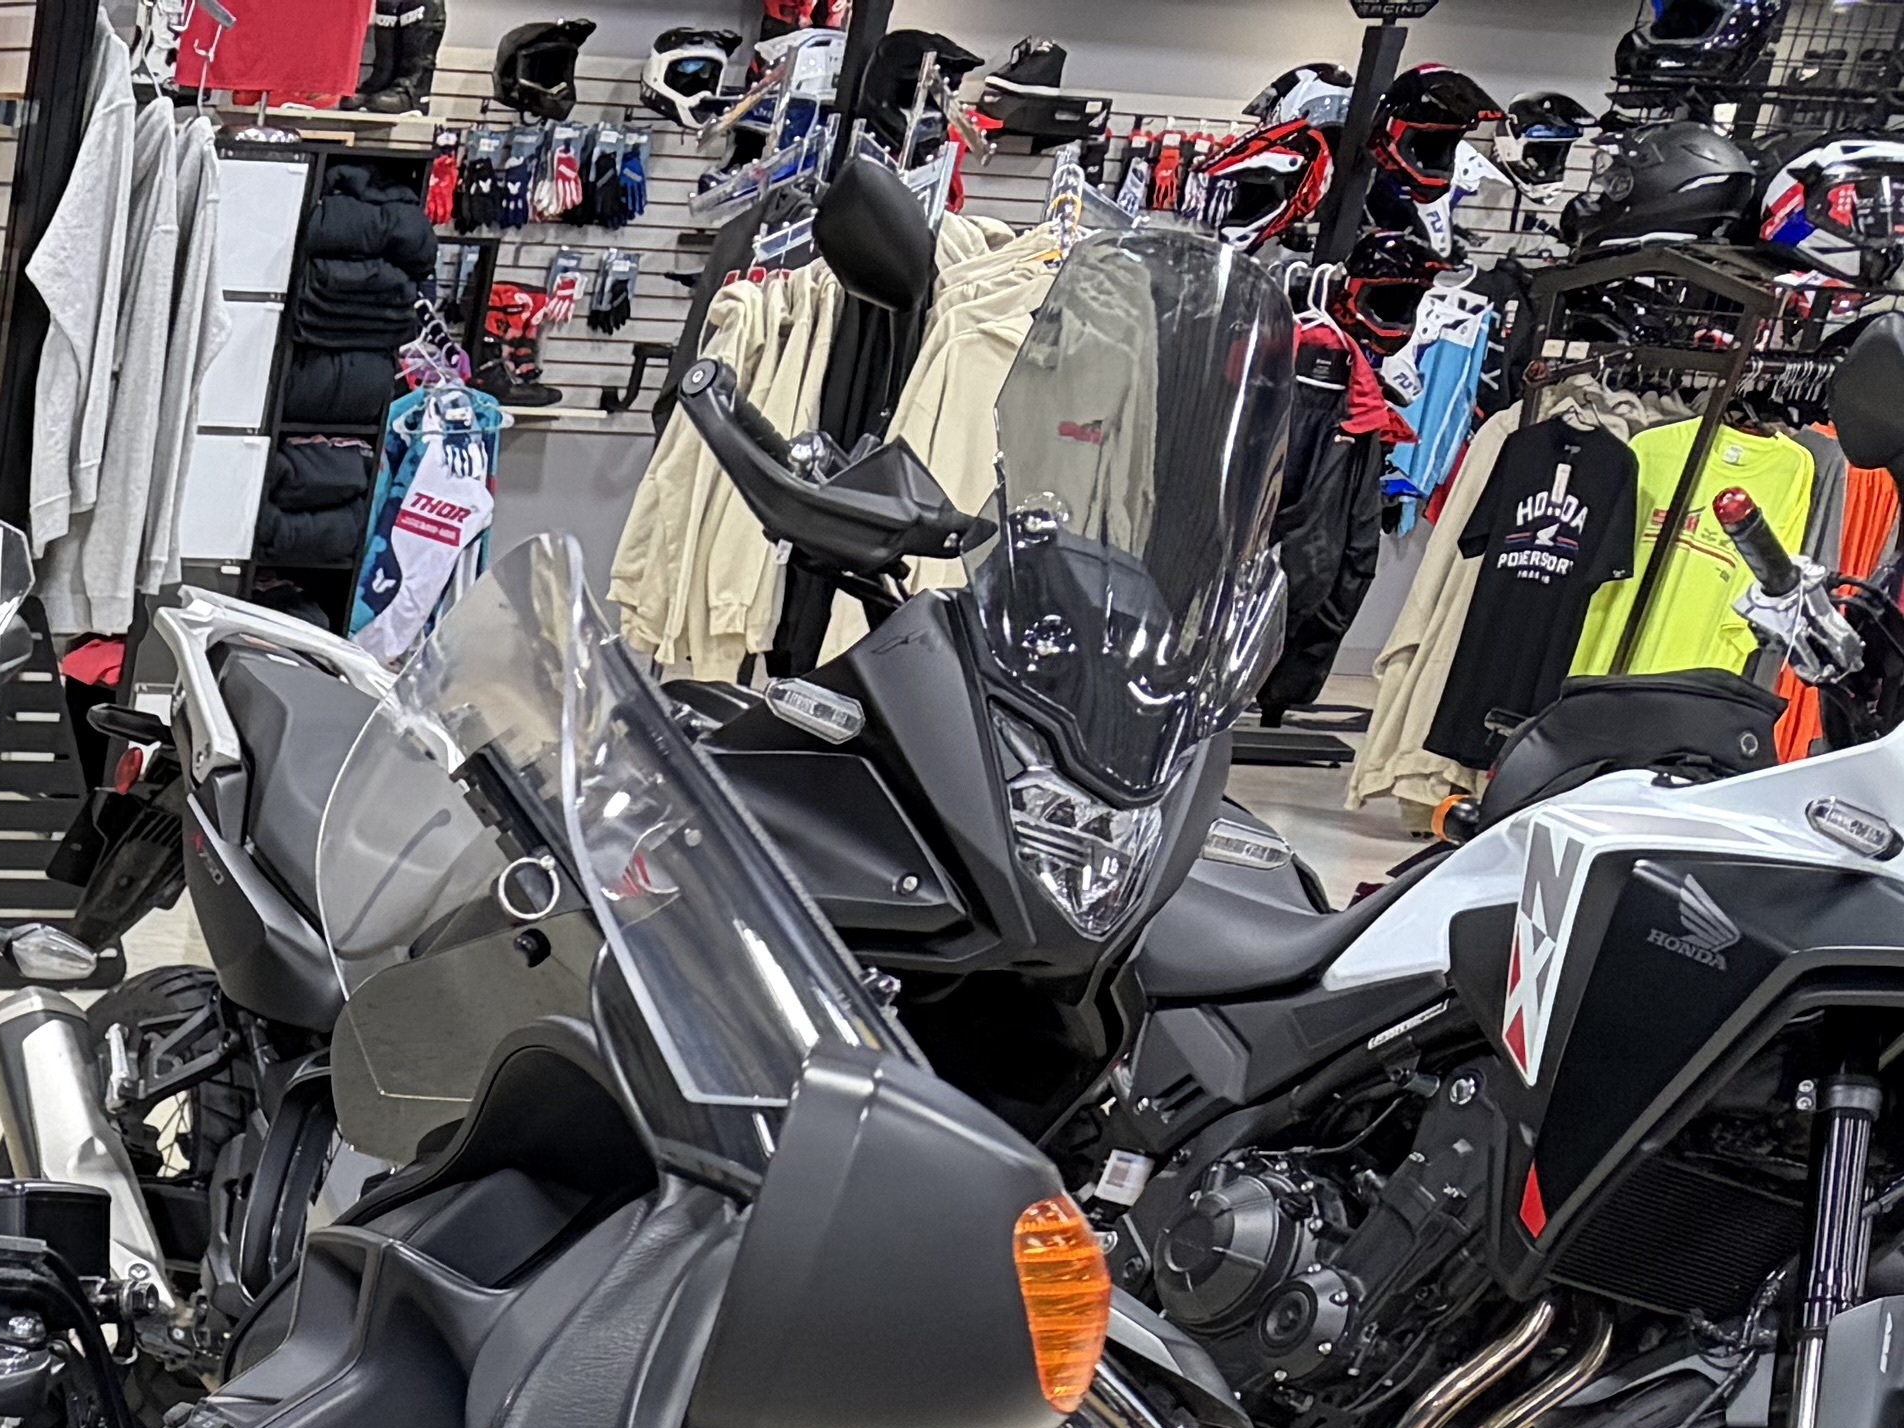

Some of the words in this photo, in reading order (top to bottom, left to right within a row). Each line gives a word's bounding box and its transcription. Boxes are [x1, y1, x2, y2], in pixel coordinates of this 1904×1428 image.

[1425, 209, 1446, 235] FLY
[1392, 370, 1421, 397] FLY
[409, 491, 472, 524] THOR
[1515, 491, 1589, 535] HODA
[1646, 927, 1728, 971] HONDA
